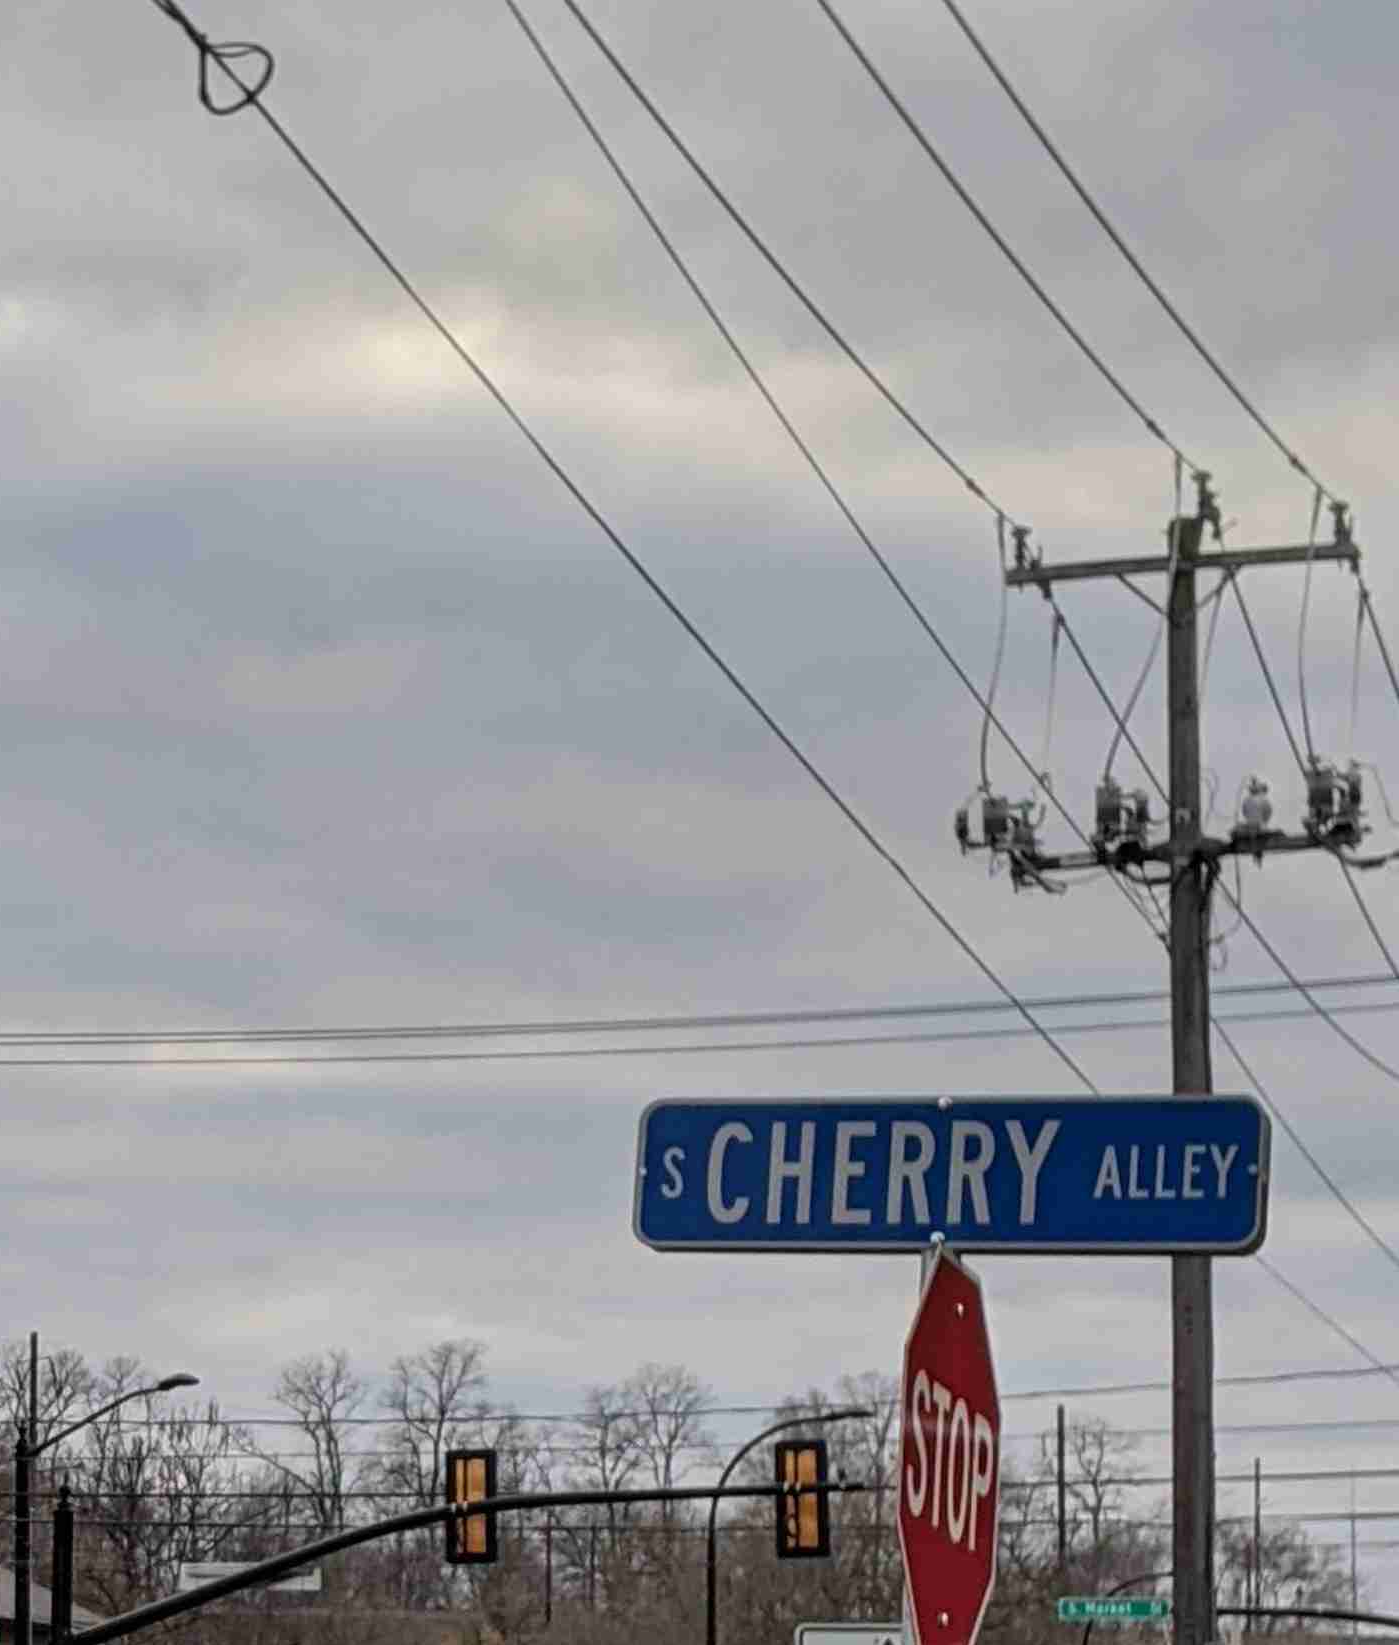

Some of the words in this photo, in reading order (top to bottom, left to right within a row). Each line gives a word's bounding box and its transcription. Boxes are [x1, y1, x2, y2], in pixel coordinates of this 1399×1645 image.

[661, 1147, 685, 1198] S
[706, 1120, 1062, 1225] CHERRY
[1094, 1145, 1239, 1199] ALLEY
[907, 1369, 994, 1551] STOP
